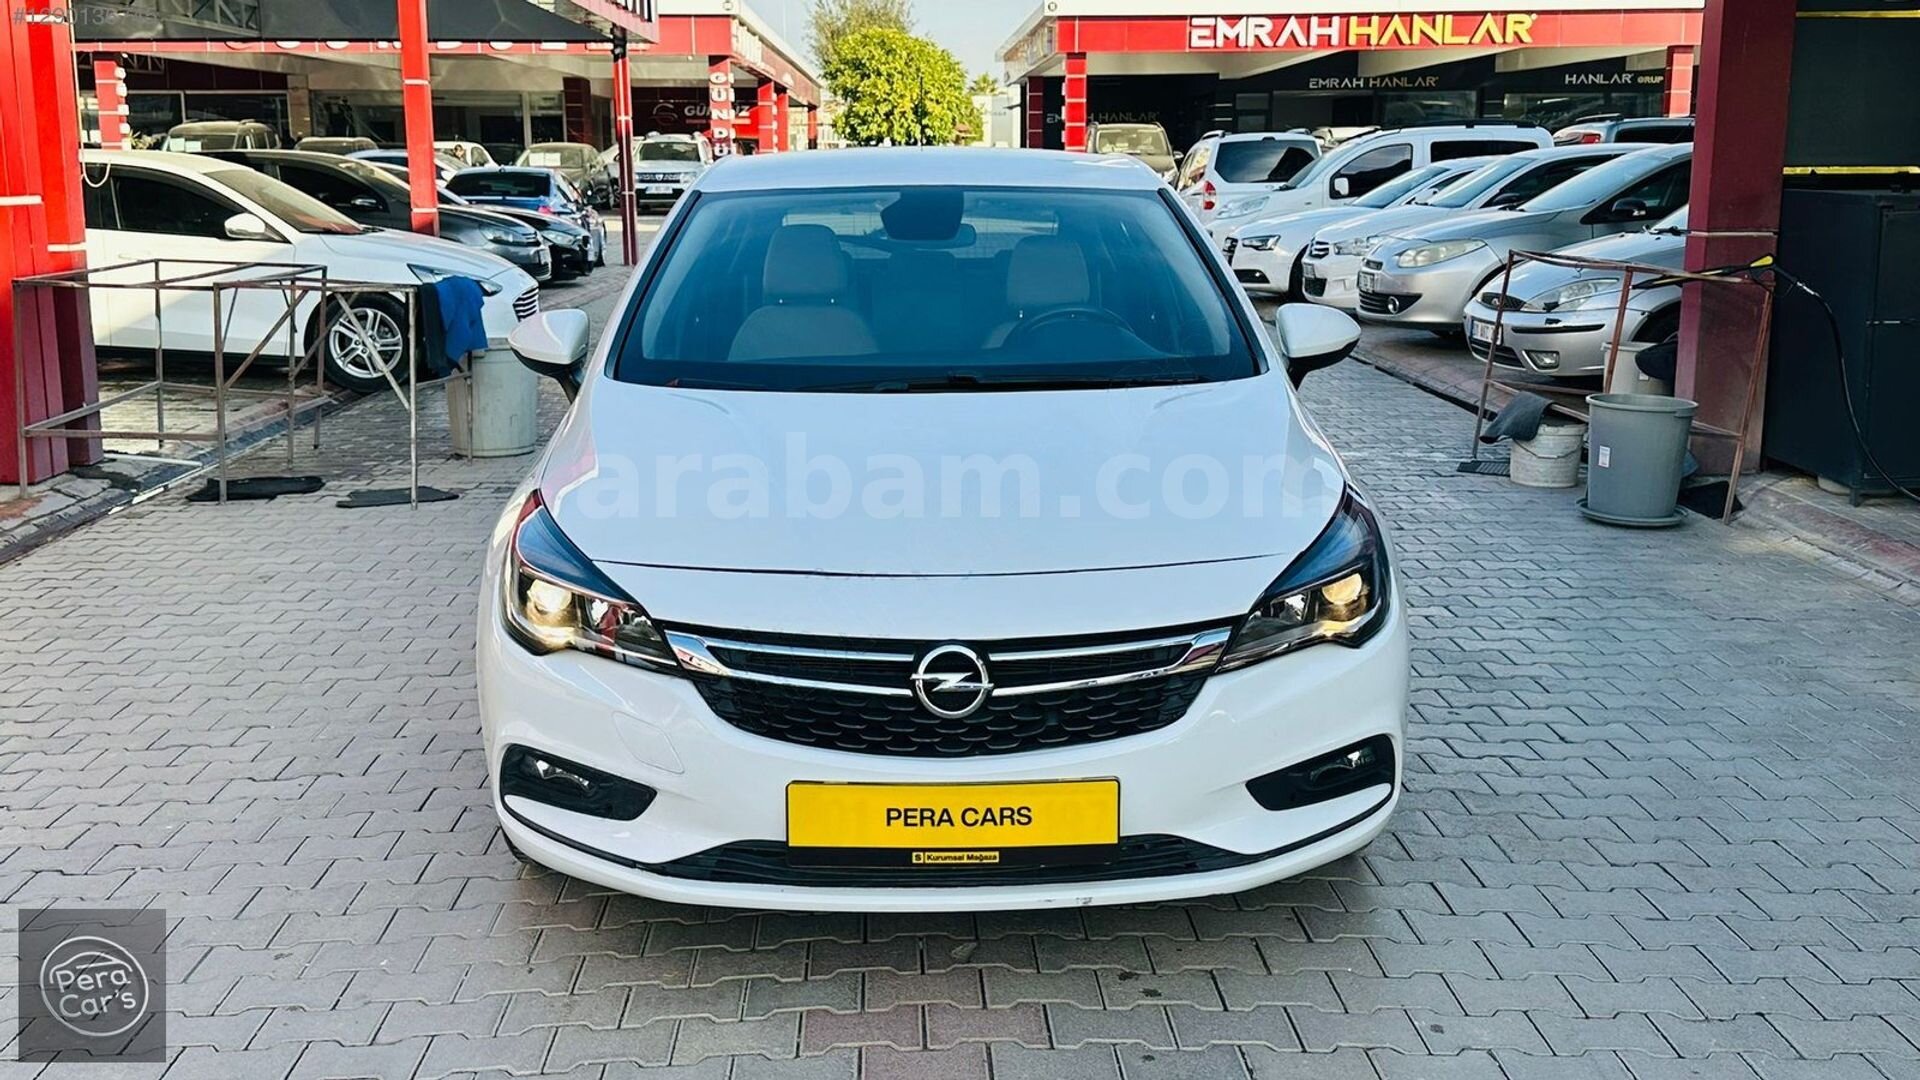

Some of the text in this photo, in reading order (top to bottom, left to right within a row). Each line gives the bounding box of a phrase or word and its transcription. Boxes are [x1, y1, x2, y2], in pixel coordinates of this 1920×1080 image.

[1190, 12, 1537, 49] EMRAH HANLAR
[1308, 76, 1439, 89] EMRAH HANLAR
[1564, 73, 1665, 85] HANLAR GRUP
[885, 806, 1033, 828] PERA CARS
[926, 853, 965, 862] Kurumsal
[967, 853, 997, 862] Mağaza
